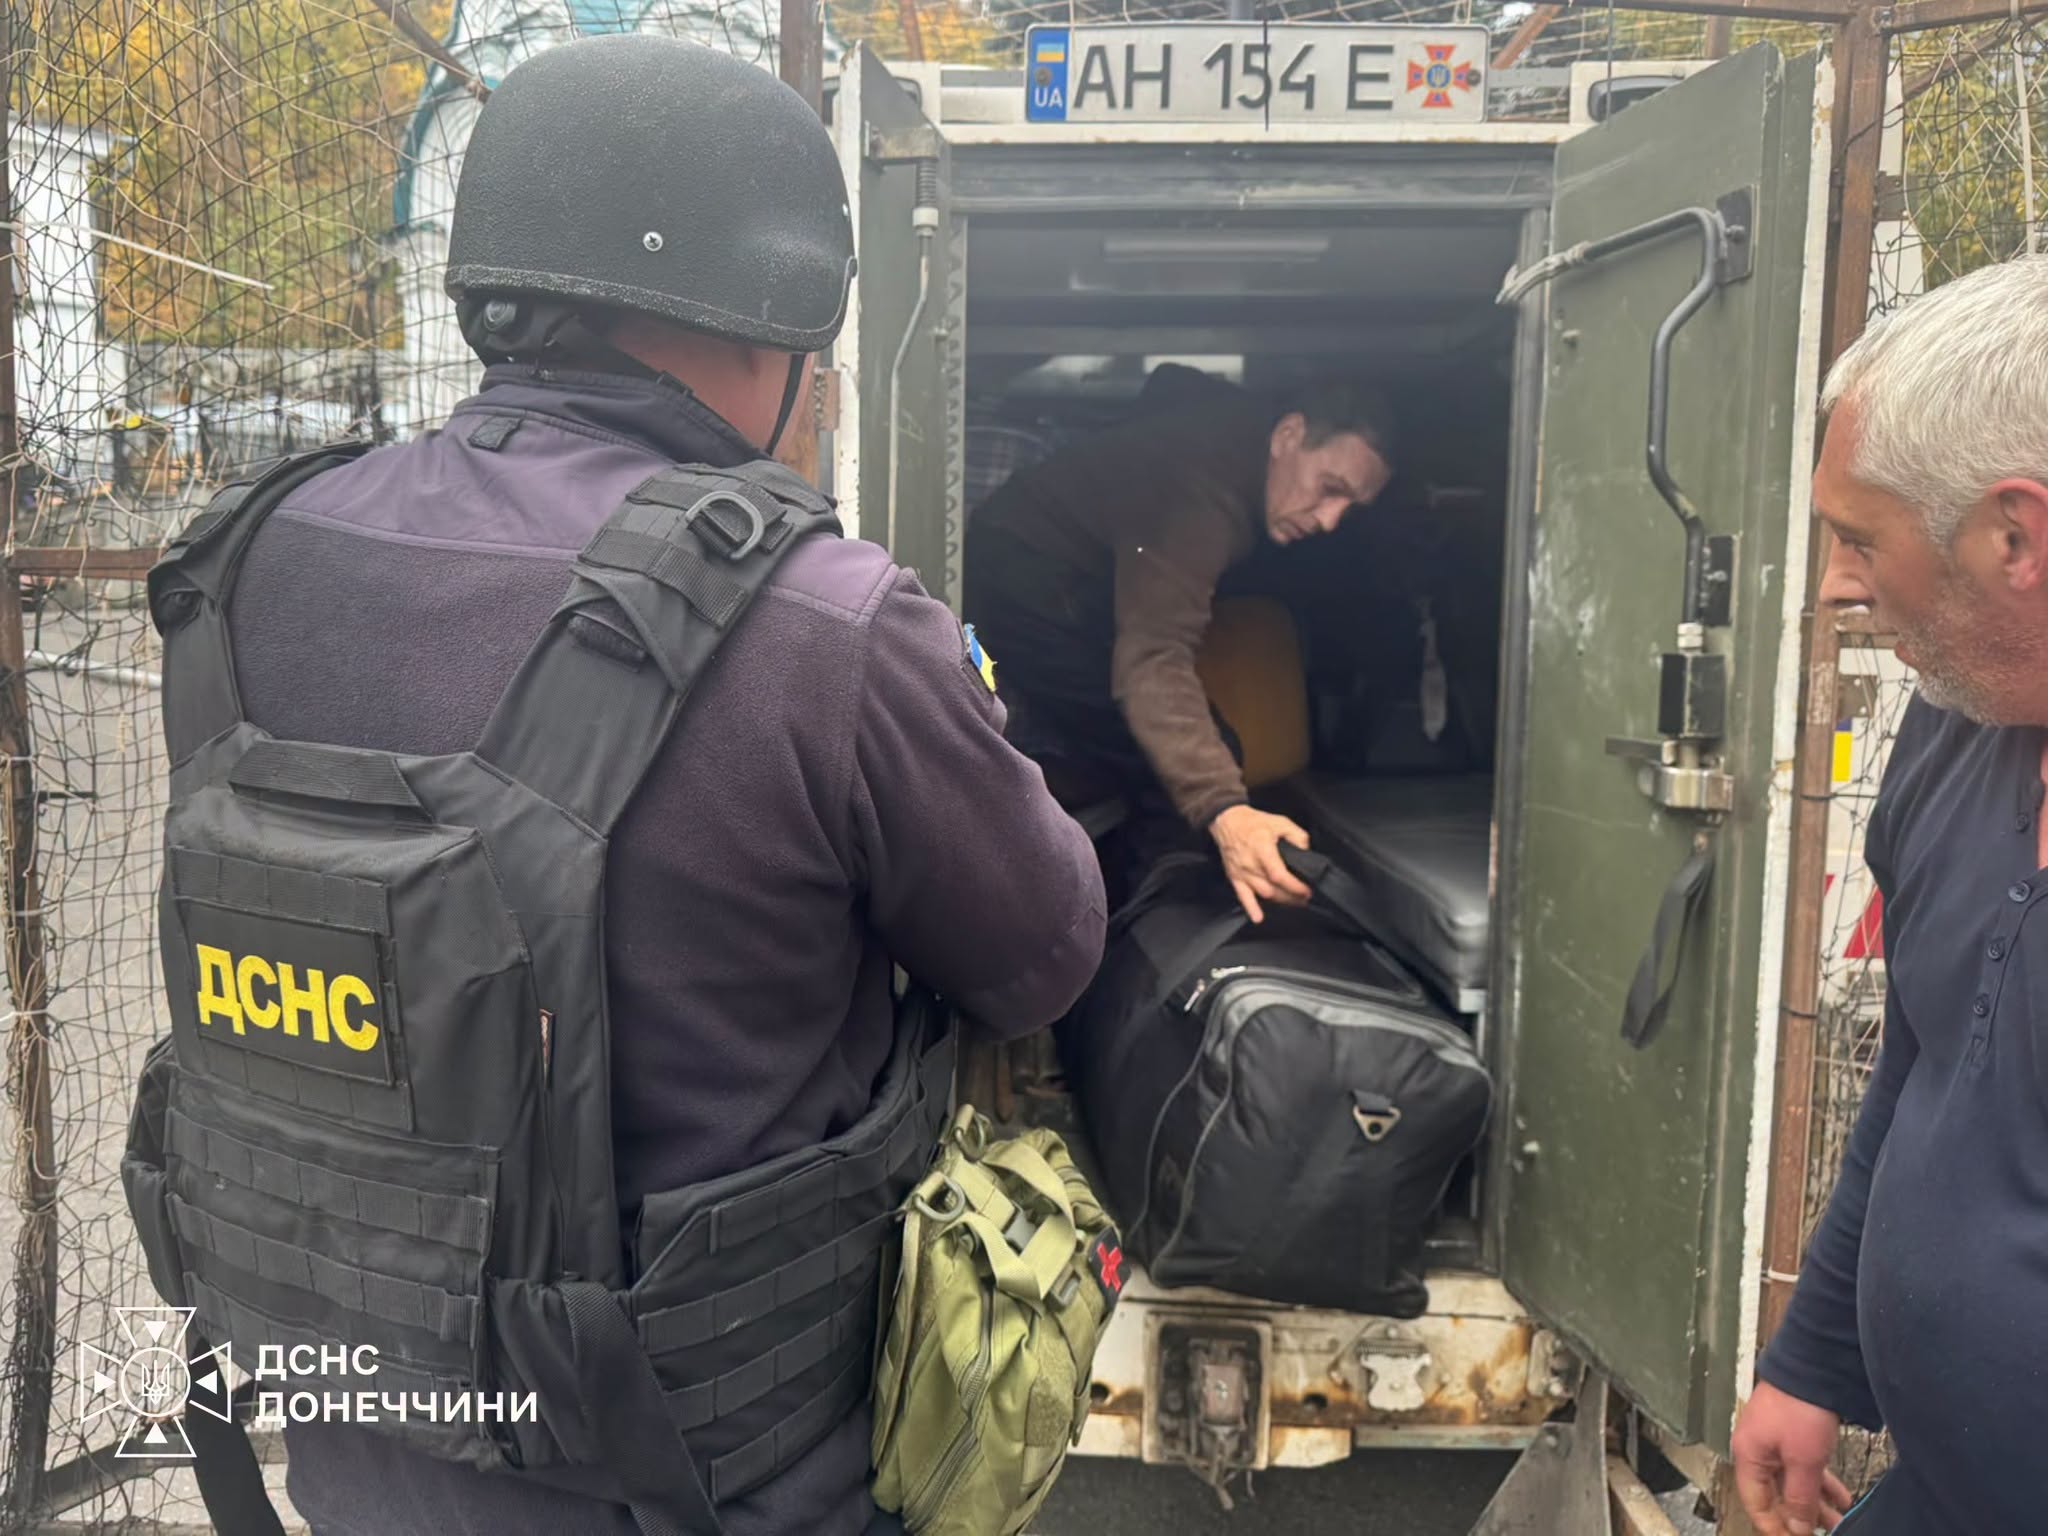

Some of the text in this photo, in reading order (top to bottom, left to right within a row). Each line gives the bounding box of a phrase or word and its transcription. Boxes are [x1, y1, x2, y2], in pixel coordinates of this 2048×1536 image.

[1034, 87, 1063, 109] UA
[1202, 43, 1316, 111] 154
[1346, 44, 1395, 111] E
[197, 943, 379, 1051] ДСНС
